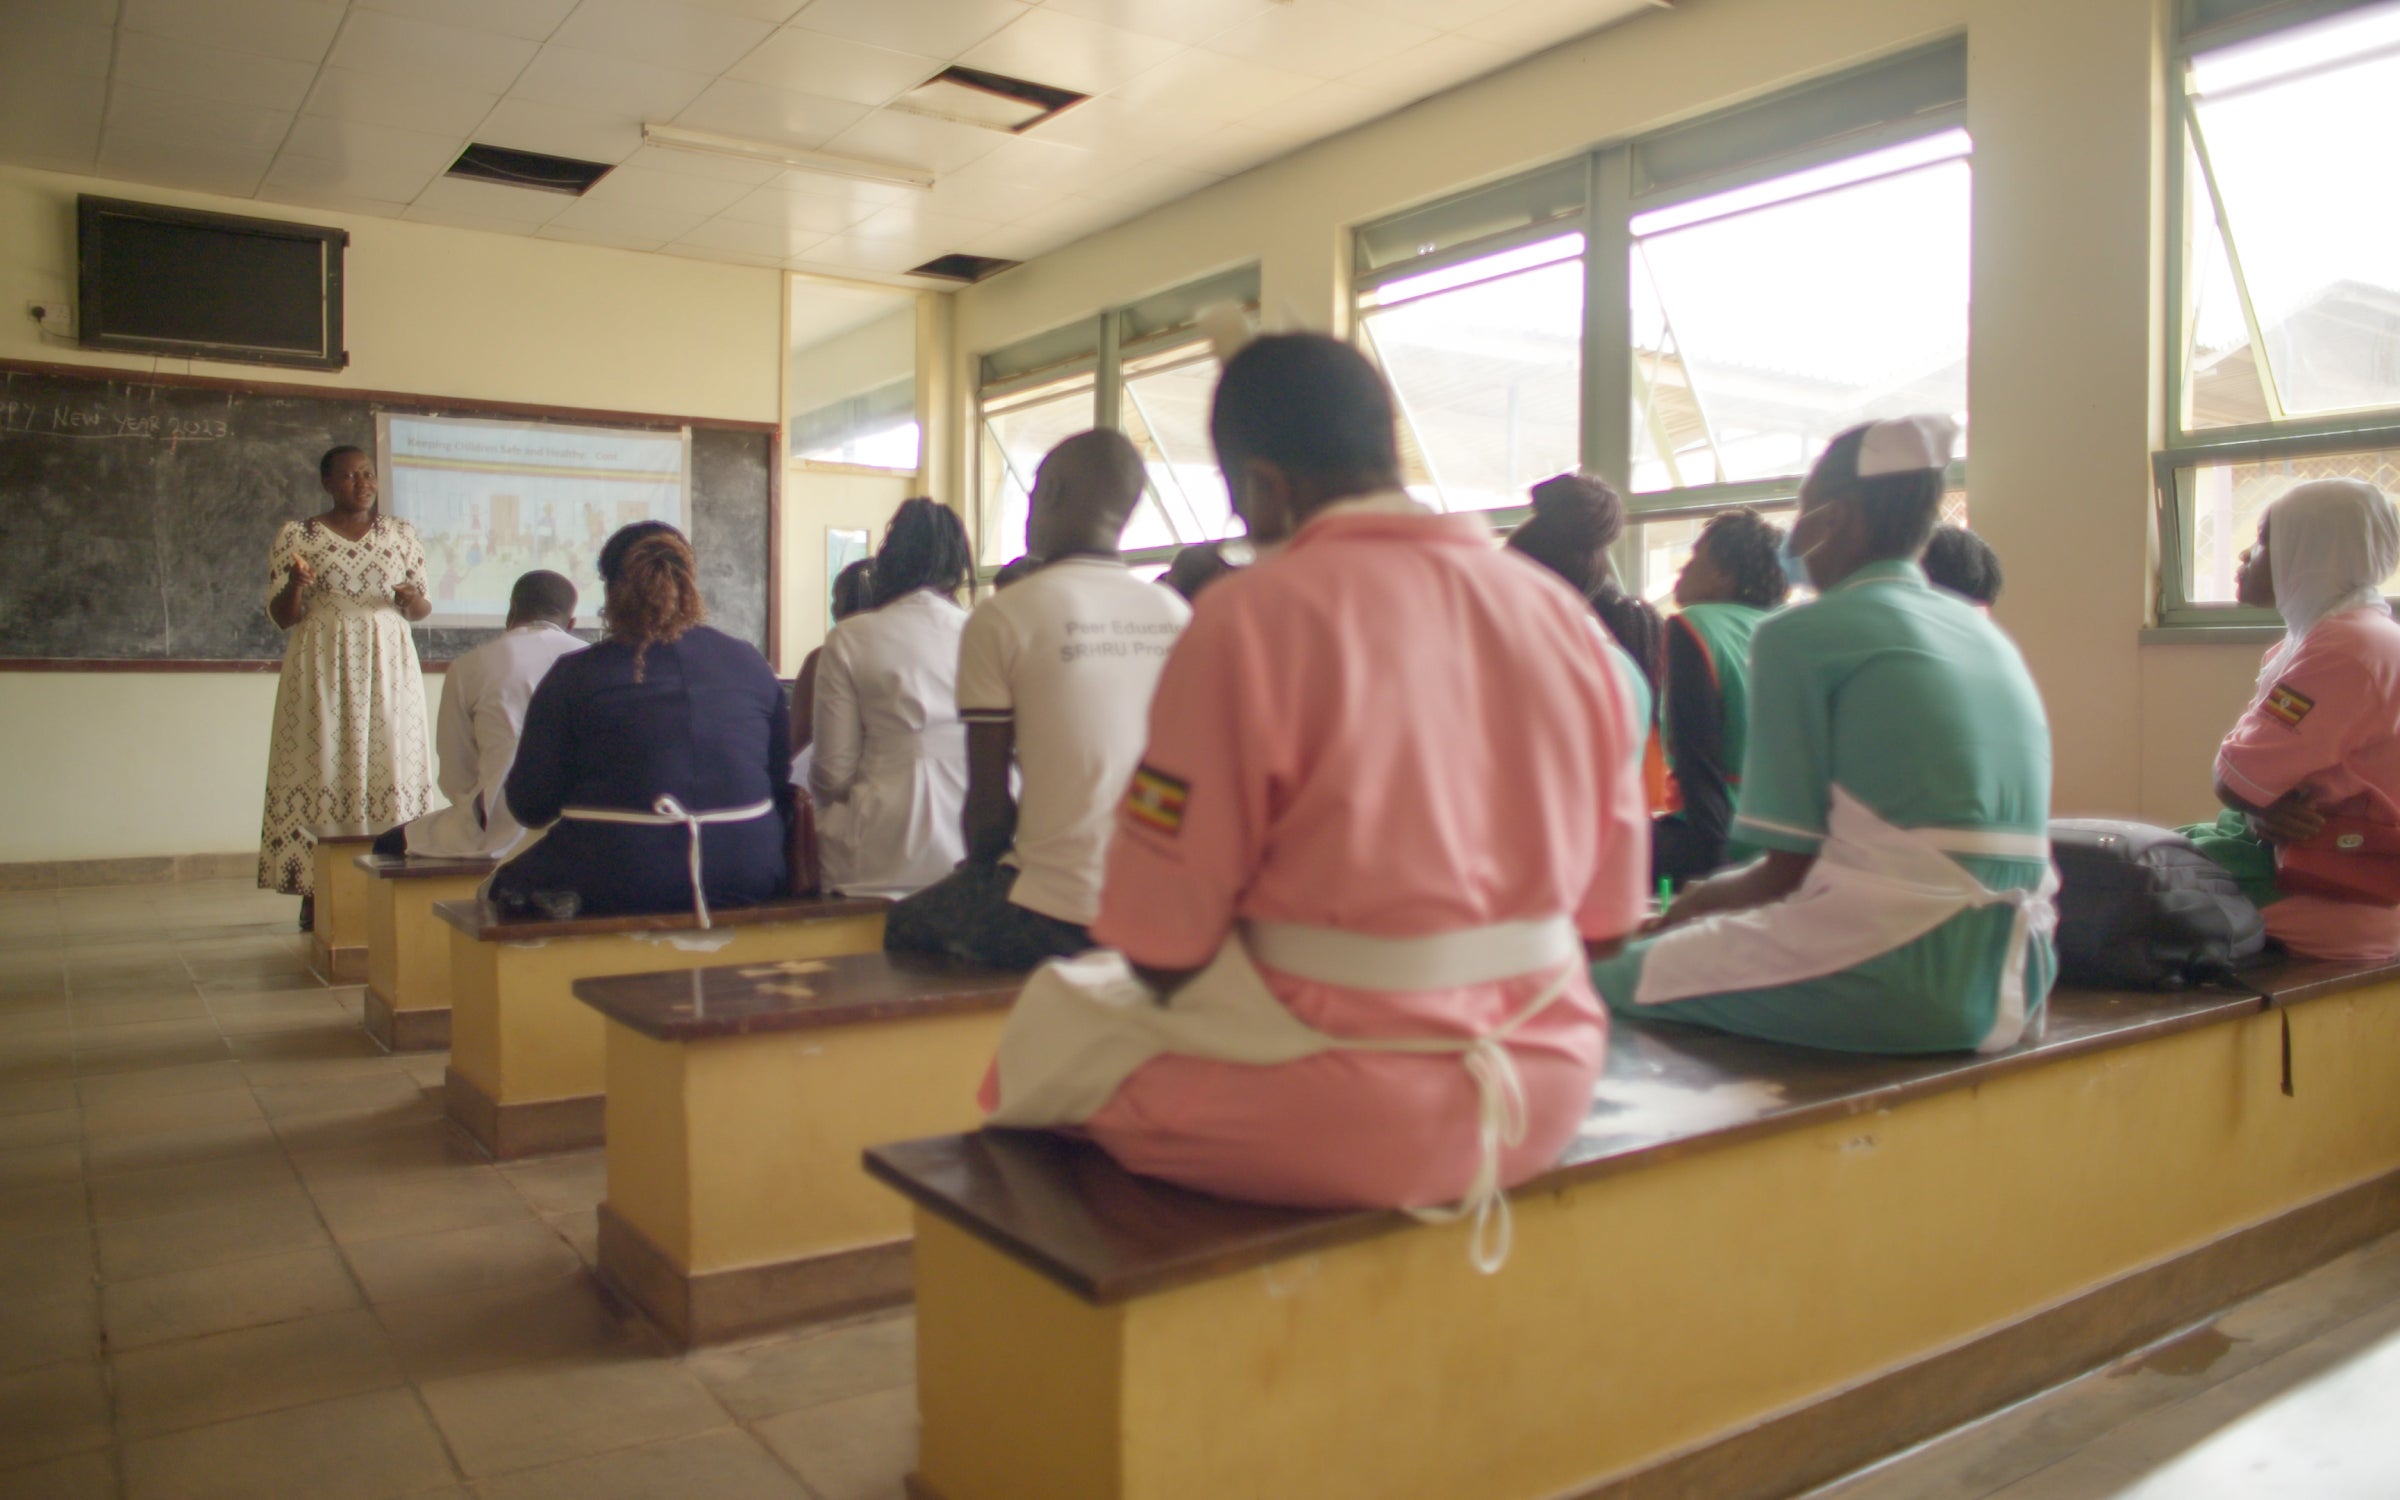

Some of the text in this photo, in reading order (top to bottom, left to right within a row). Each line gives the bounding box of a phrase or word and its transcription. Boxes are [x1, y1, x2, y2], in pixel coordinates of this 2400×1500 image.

[407, 437, 451, 452] Keeping
[454, 440, 498, 454] Children
[500, 445, 522, 456] Safe
[524, 448, 544, 457] and
[1065, 621, 1105, 636] Peer
